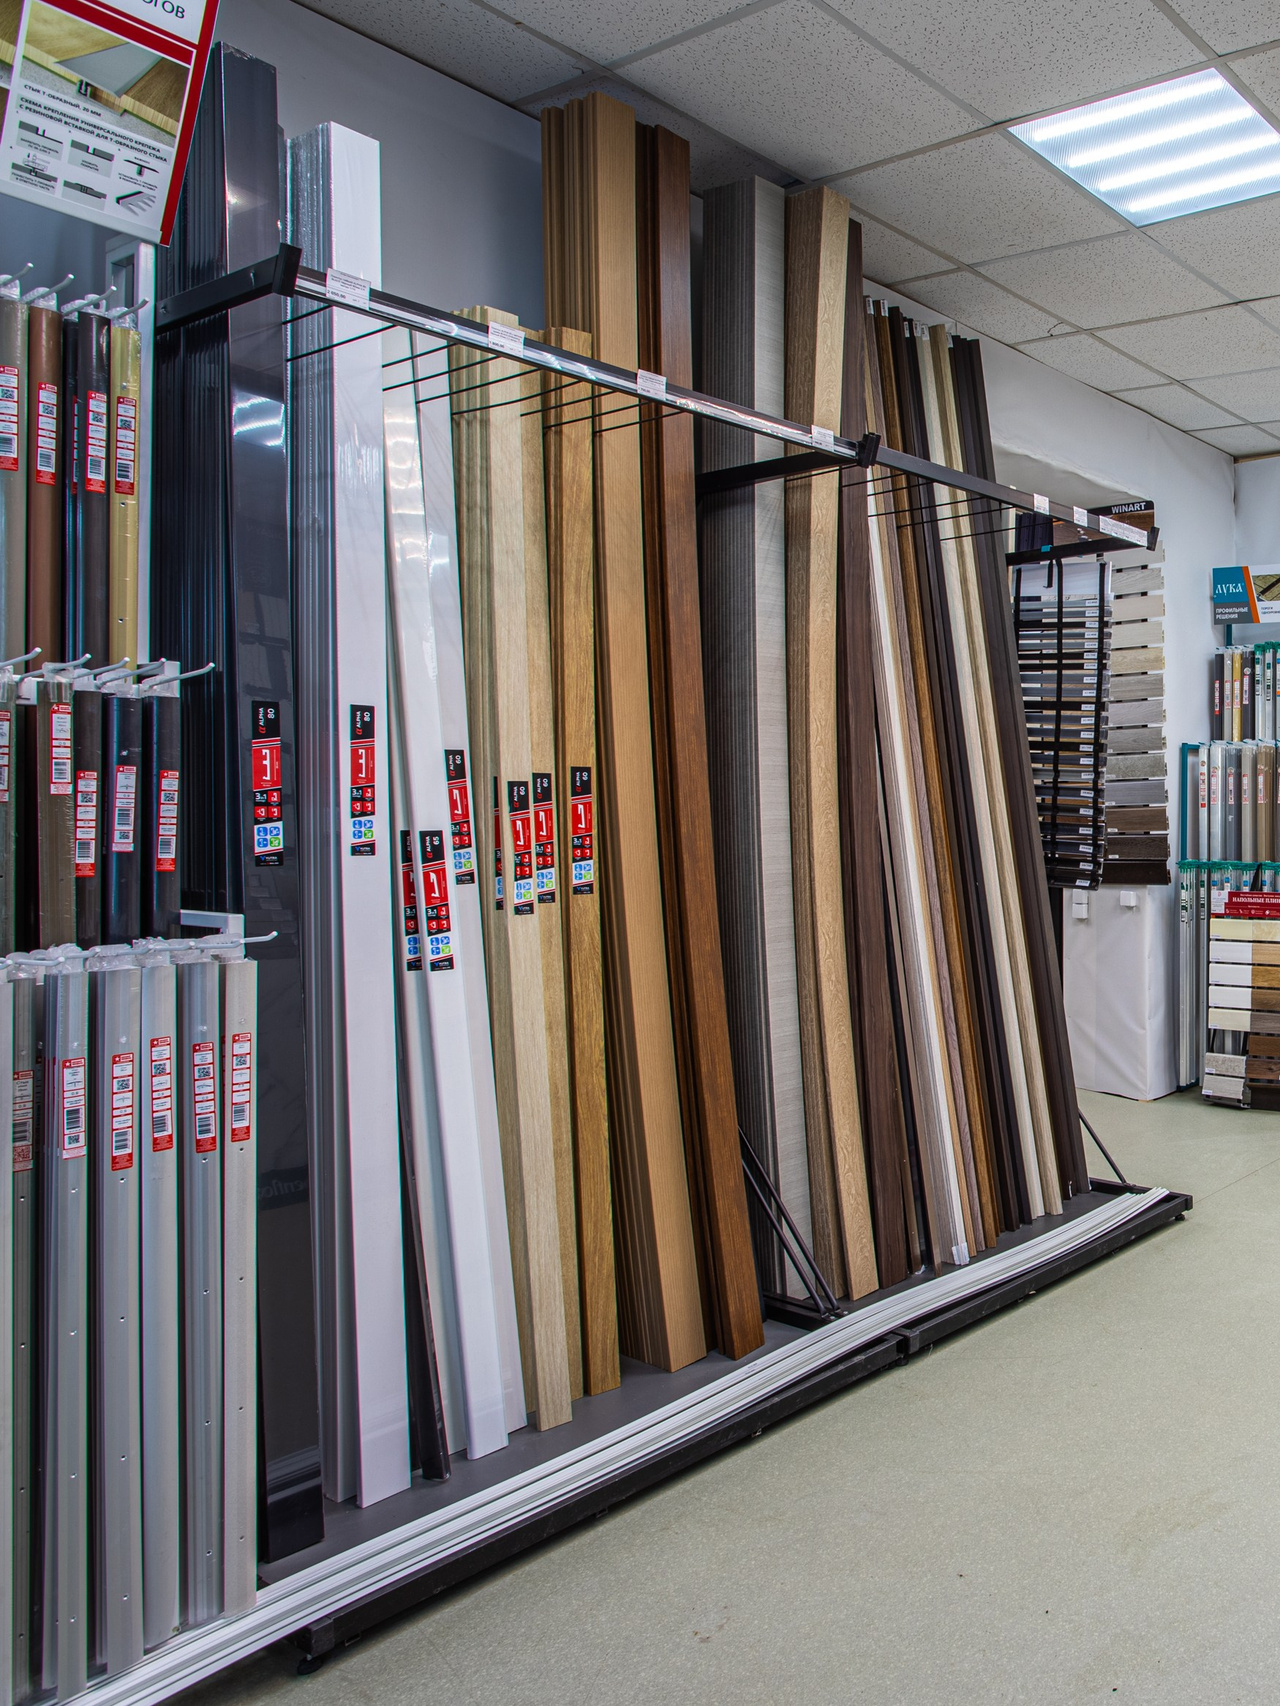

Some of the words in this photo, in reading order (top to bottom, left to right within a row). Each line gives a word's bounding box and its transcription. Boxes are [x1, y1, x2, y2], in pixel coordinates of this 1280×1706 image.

[24, 84, 42, 93] СТЫК
[20, 97, 42, 109] СХЕМА
[43, 105, 80, 123] КРЕПЛЕНИЯ
[80, 118, 134, 143] УНИВЕРСАЛЬНОГО
[134, 139, 161, 154] КРЕПЕЖА
[25, 106, 63, 124] РЕЗИНОВОЙ
[64, 120, 95, 136] ВСТАВКОЙ
[148, 152, 168, 163] СТЫКА
[1111, 502, 1146, 514] WINART
[1215, 583, 1243, 596] ЛУКА
[1215, 606, 1249, 614] ПРОФИЛЬНЫЕ
[267, 708, 275, 719] 80
[363, 711, 371, 722] 80
[455, 755, 461, 764] 60
[582, 772, 588, 781] 60
[542, 778, 549, 787] 60
[519, 786, 526, 795] 60
[432, 836, 440, 845] 65
